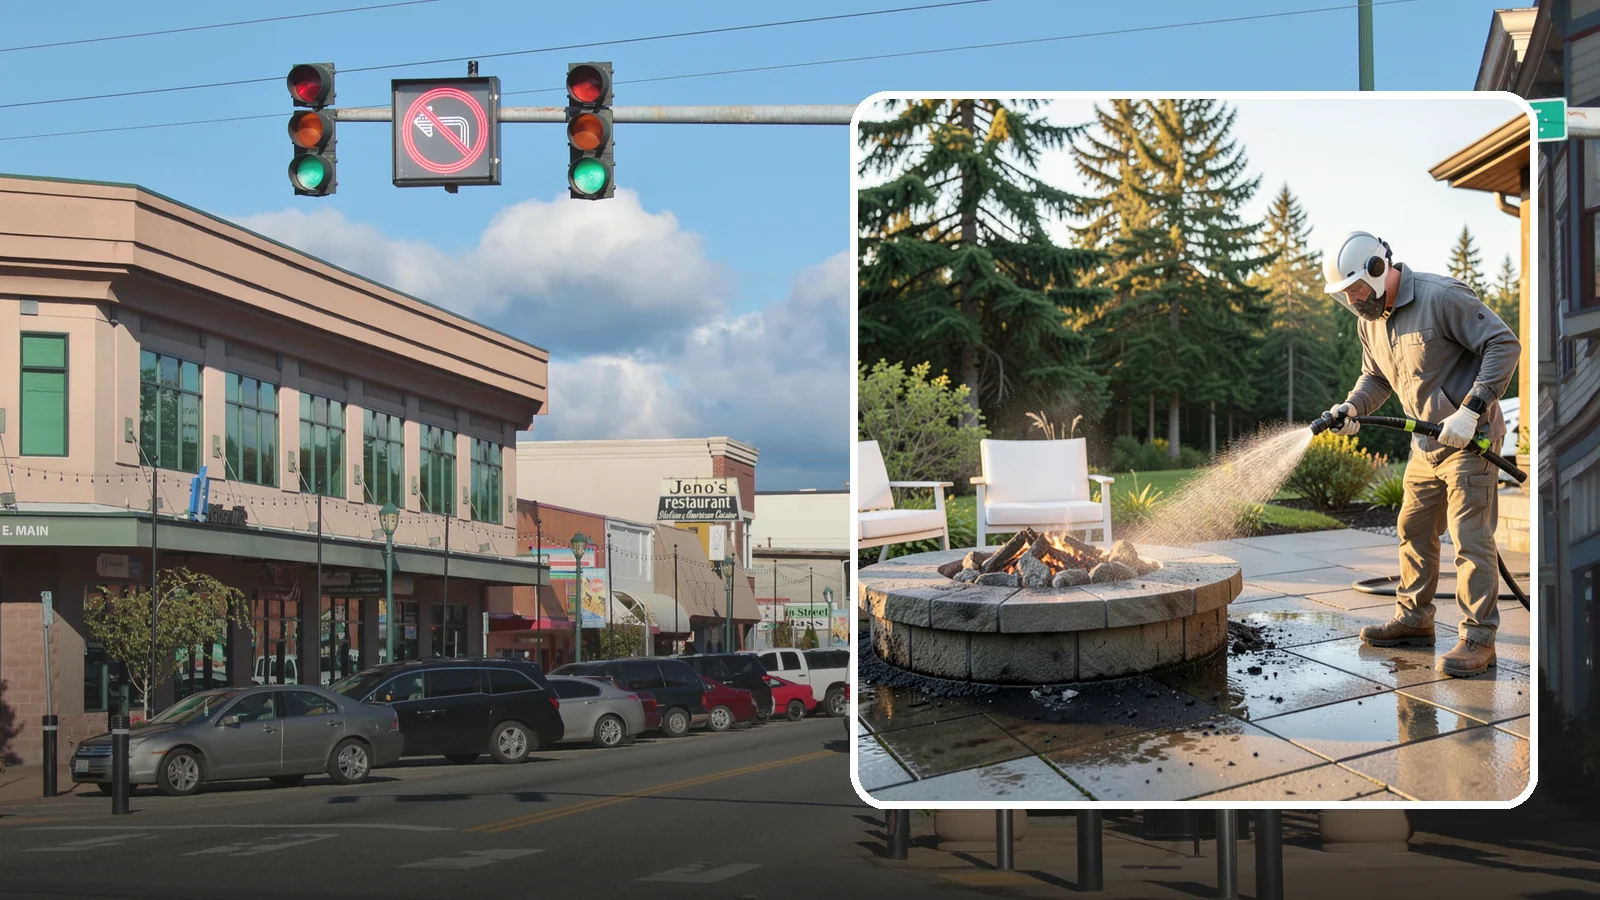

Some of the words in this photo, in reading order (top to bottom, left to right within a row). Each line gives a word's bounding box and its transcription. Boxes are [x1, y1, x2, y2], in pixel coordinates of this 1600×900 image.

[670, 480, 727, 495] Jeno's
[665, 497, 731, 509] restaurant
[658, 510, 681, 519] Italian
[686, 510, 715, 519] American
[715, 510, 738, 519] Cuisine
[2, 525, 13, 536] E.
[15, 525, 49, 536] MAIN
[797, 607, 829, 617] Street
